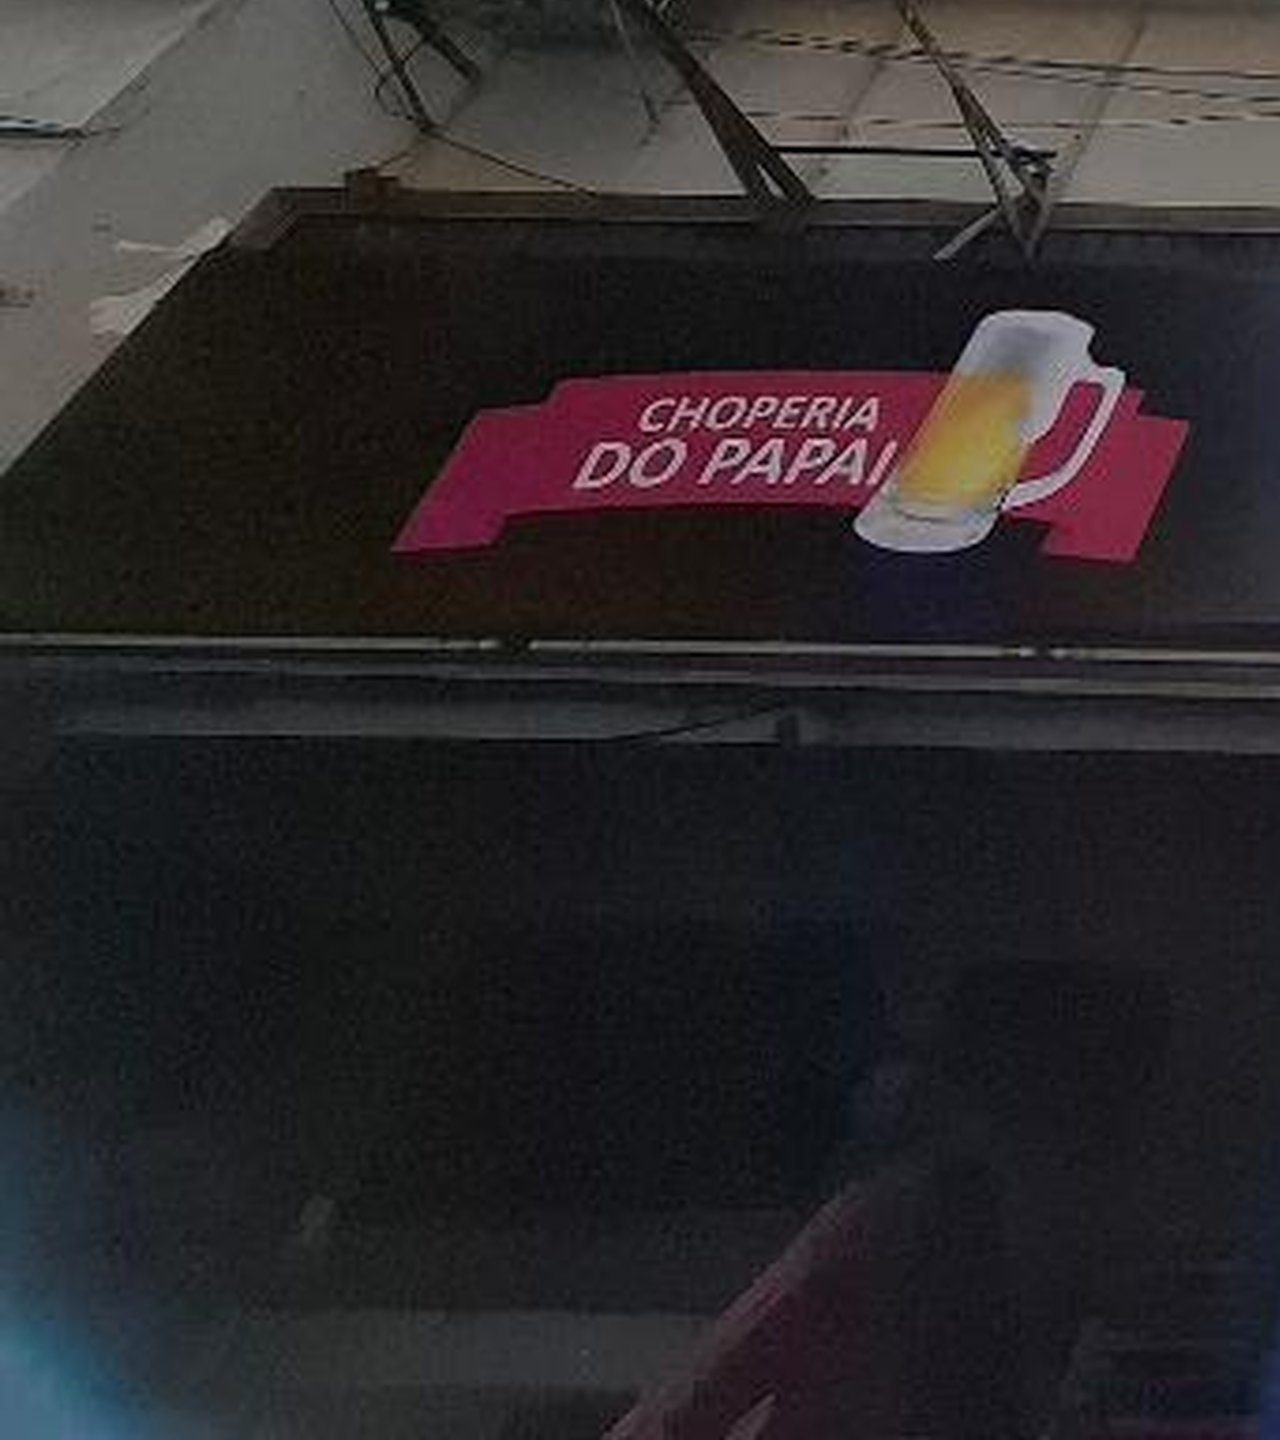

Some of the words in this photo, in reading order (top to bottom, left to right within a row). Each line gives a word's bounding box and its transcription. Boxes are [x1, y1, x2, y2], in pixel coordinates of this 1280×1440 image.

[638, 396, 880, 431] CHOPERIA
[572, 437, 688, 490] DO
[696, 436, 899, 486] PAPAI
